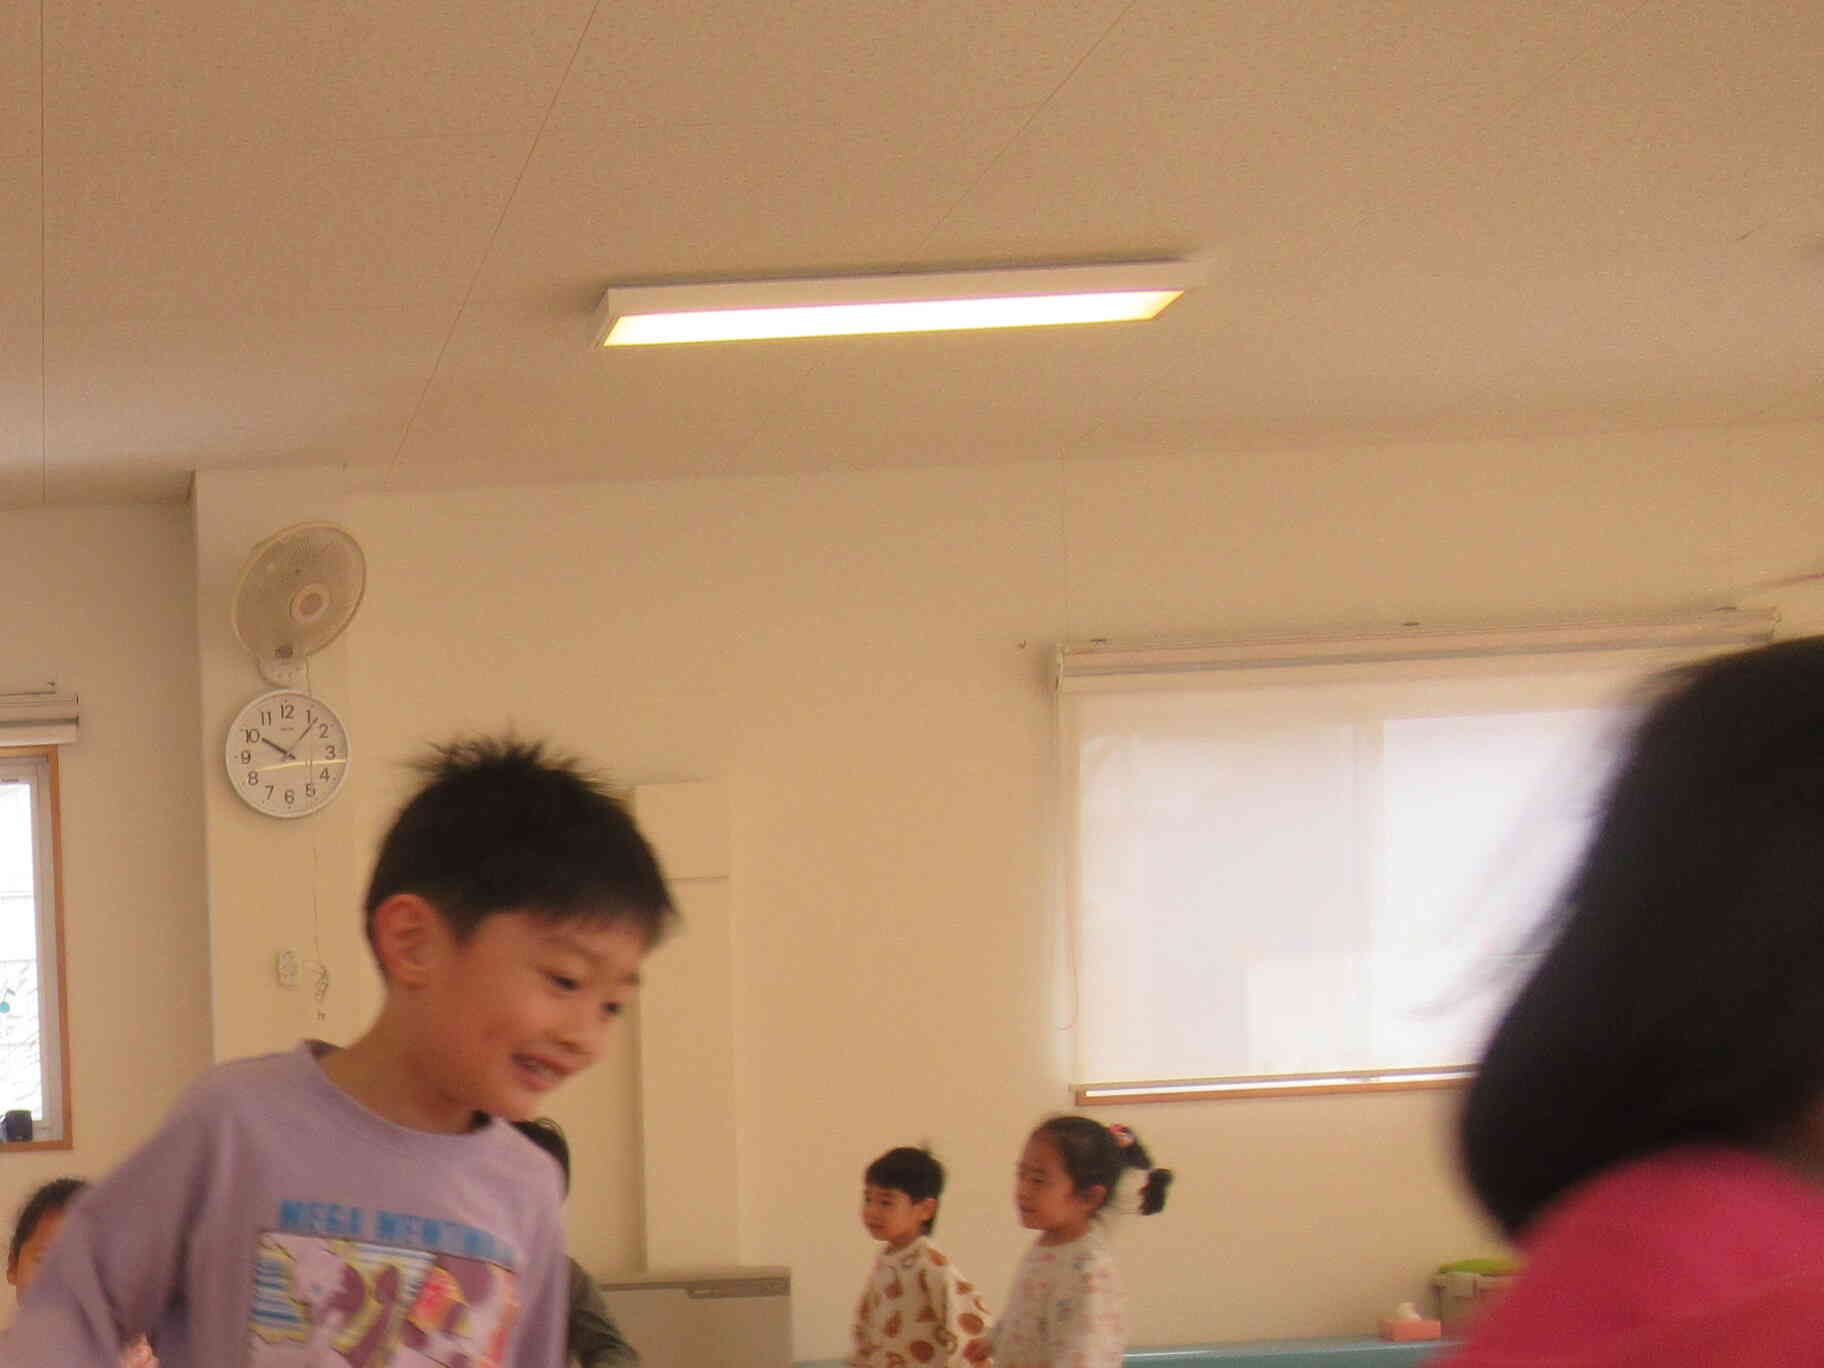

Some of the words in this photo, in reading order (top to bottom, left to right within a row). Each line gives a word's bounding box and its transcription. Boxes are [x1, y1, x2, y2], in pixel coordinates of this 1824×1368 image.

[261, 711, 272, 726] 11
[280, 704, 295, 720] 12
[306, 709, 311, 724] 1
[245, 728, 260, 743] 10
[319, 723, 329, 739] 2
[240, 750, 251, 765] 9
[325, 745, 336, 760] 3
[248, 770, 258, 786] 8
[319, 767, 330, 783] 4
[265, 784, 274, 800] 7
[284, 789, 295, 804] 6
[305, 783, 316, 798] 5
